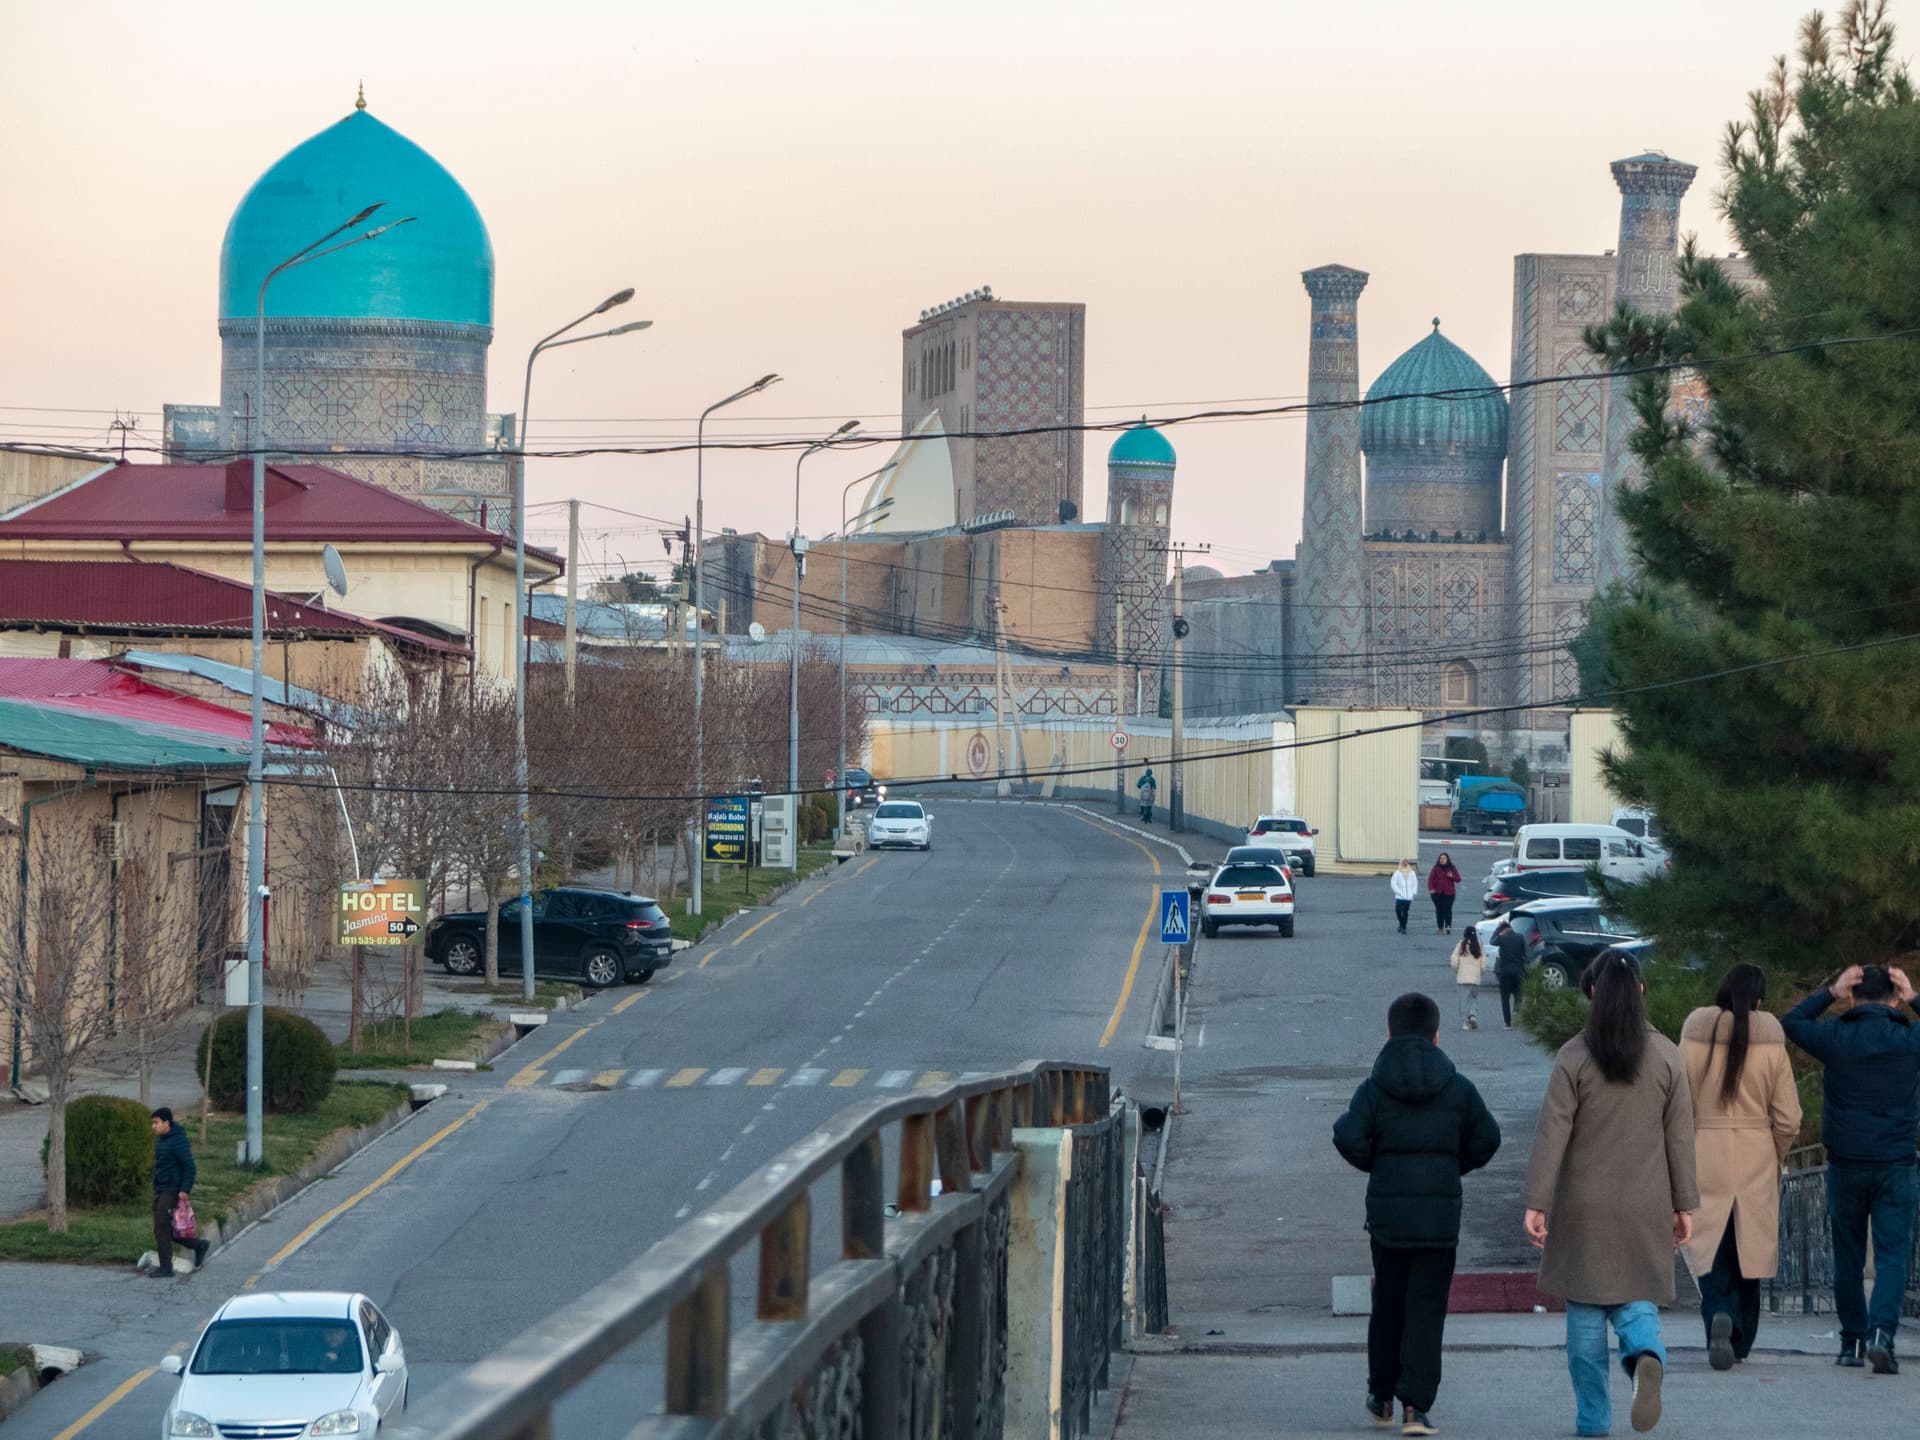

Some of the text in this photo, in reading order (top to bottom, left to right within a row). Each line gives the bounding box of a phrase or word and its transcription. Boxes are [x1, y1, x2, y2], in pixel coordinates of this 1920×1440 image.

[1114, 736, 1125, 745] 30
[342, 892, 421, 912] HOTEL
[343, 912, 388, 936] Jasmina
[389, 922, 418, 932] 50 m
